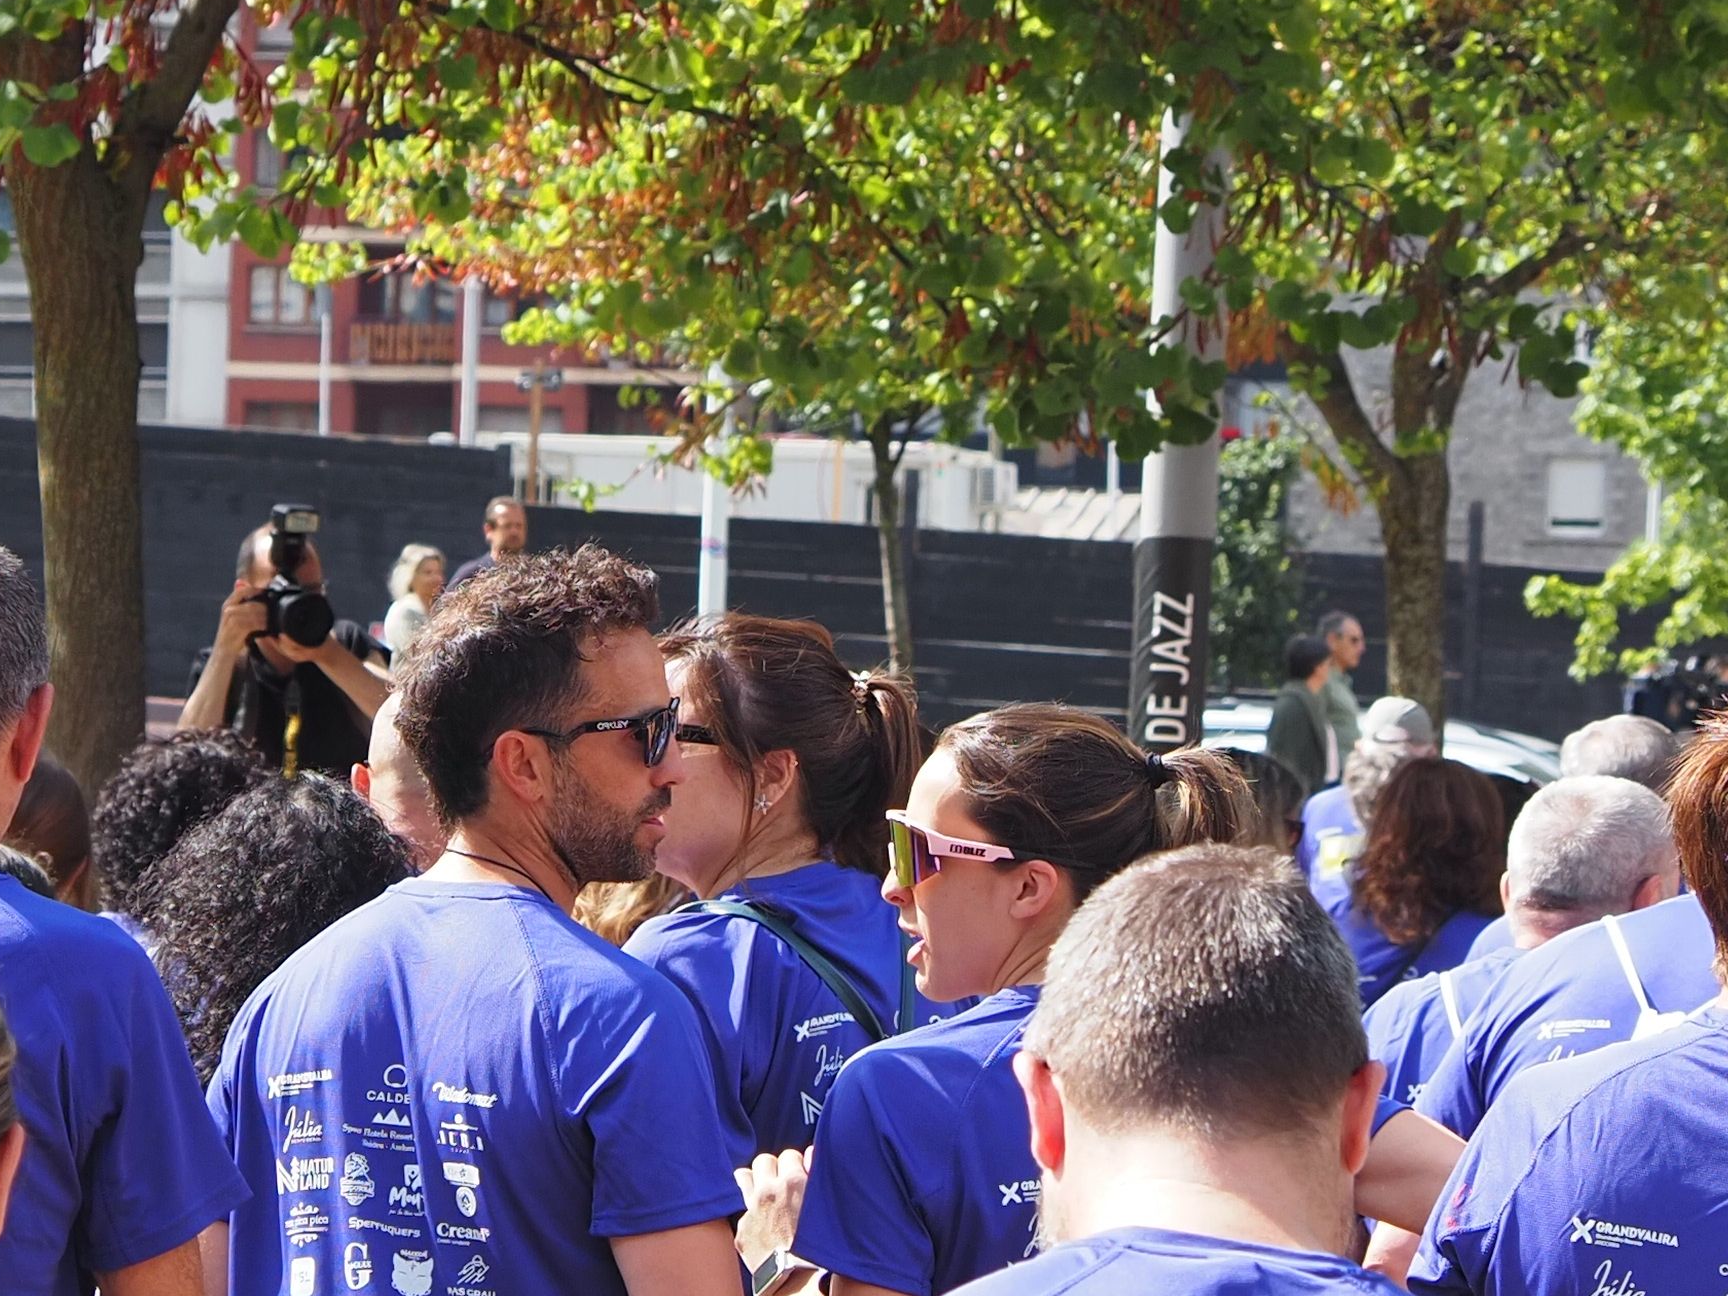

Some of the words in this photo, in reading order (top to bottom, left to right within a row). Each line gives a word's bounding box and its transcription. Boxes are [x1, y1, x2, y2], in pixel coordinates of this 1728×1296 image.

[1149, 590, 1195, 685] JAZZ
[1145, 692, 1188, 744] DE
[299, 1157, 335, 1175] NATUR
[299, 1173, 330, 1191] LAND
[348, 1216, 421, 1239] Sperruquers
[1595, 1220, 1680, 1248] GRANDVALIRA
